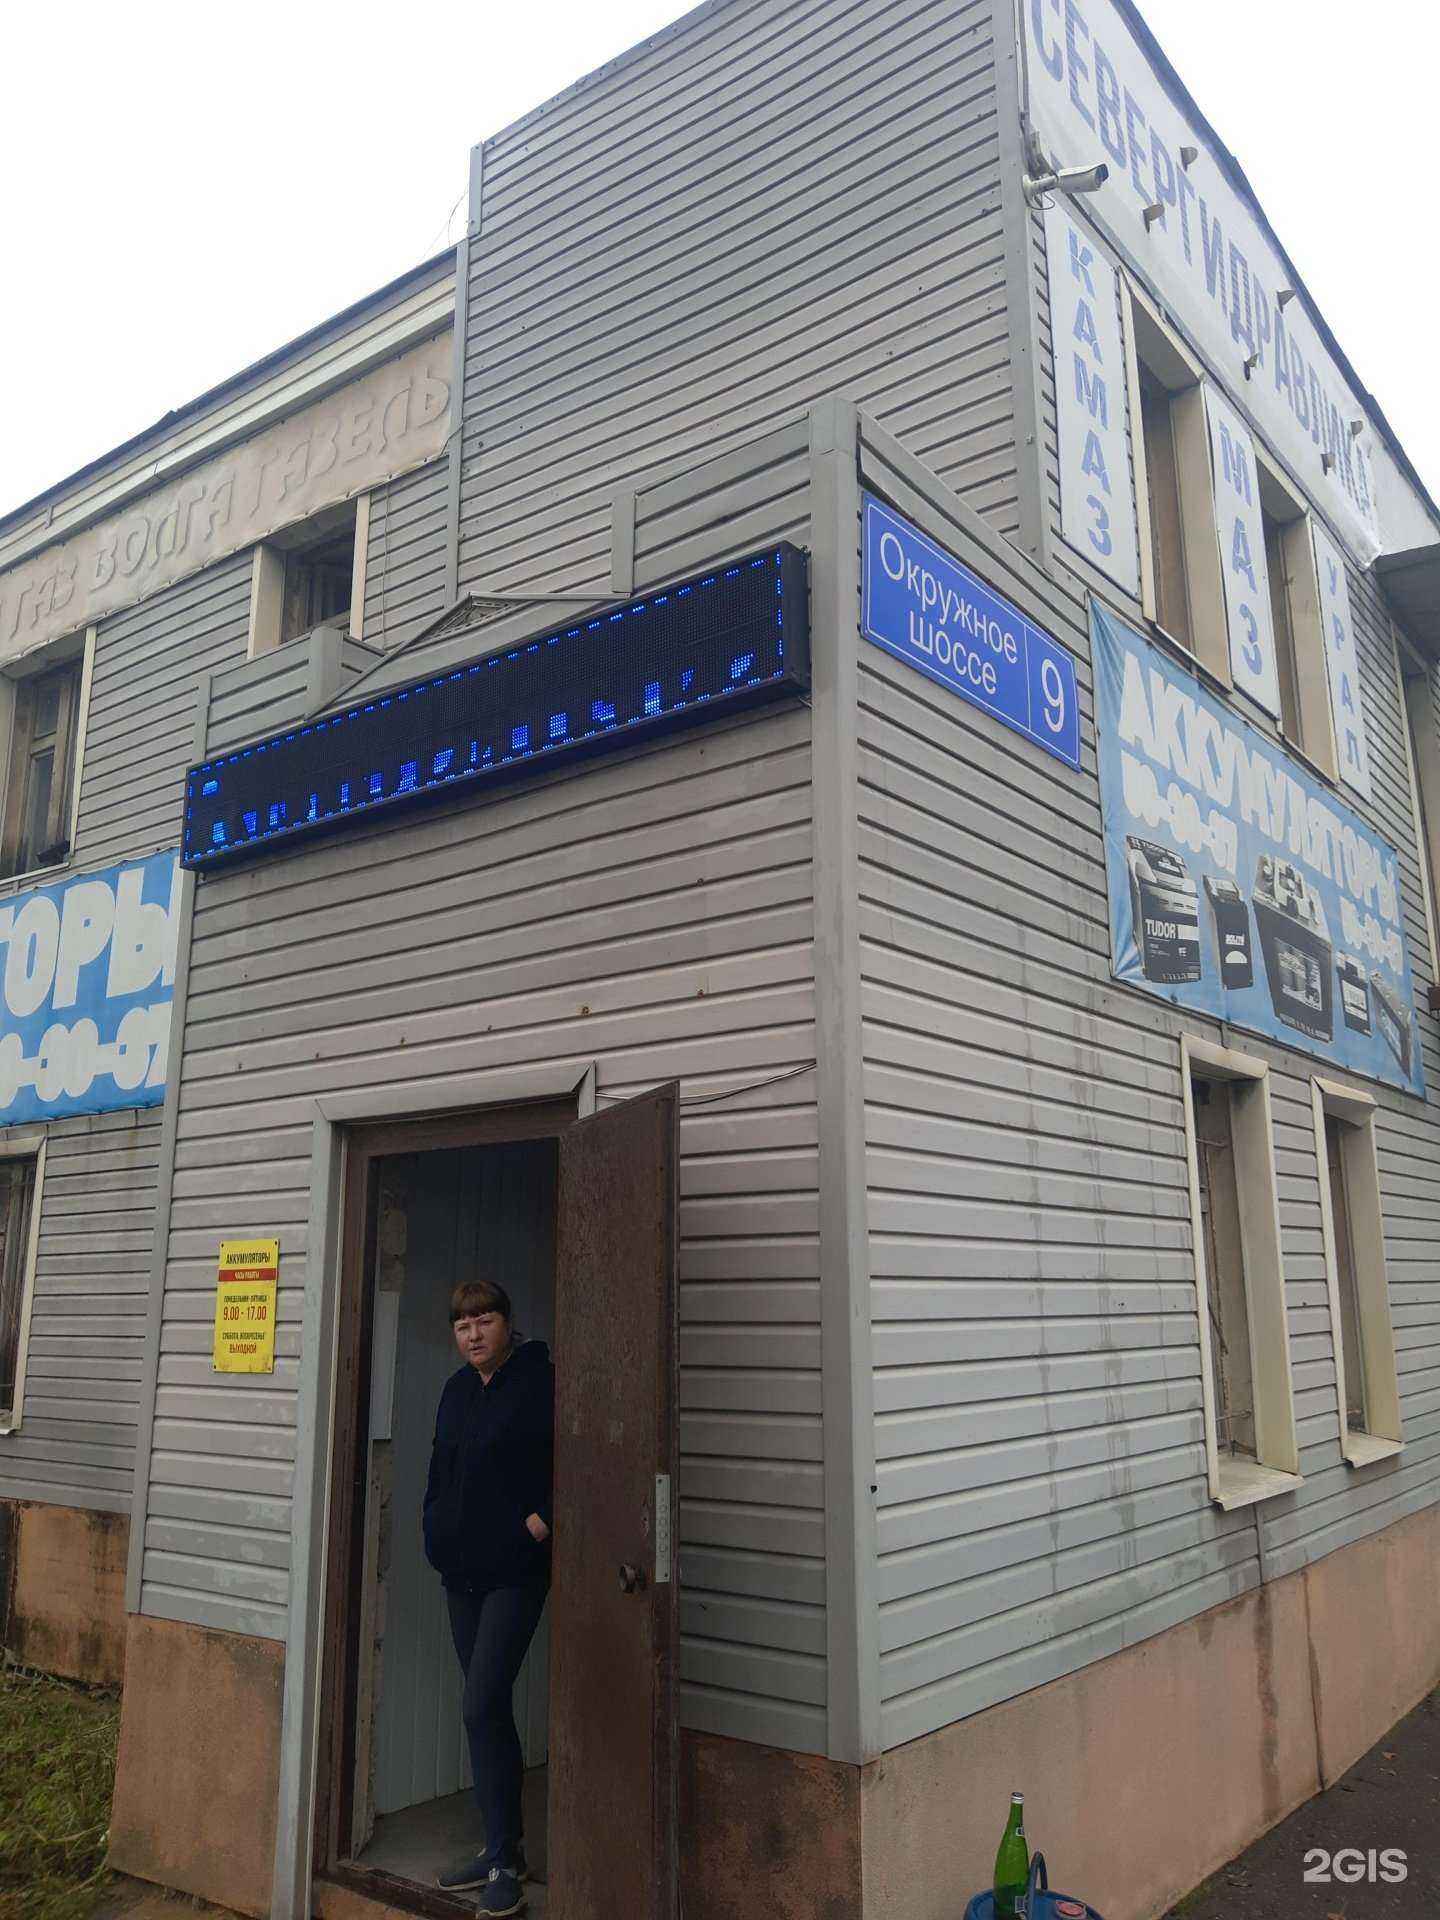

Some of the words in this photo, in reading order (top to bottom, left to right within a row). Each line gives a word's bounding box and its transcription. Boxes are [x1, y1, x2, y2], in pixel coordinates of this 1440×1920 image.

[1066, 227, 1112, 556] КАМАЗ
[880, 532, 1018, 664] Окружное
[1218, 420, 1262, 675] МАЗ
[909, 611, 997, 695] шоссе
[1041, 658, 1065, 733] 9
[1326, 557, 1361, 773] УРАЛ
[1118, 650, 1400, 926] АККУМУЛЯТОРЫ
[1145, 919, 1177, 939] TUDOR
[226, 1252, 270, 1264] АККУМУЛЯТОРЫ
[223, 1306, 240, 1320] 9.00
[247, 1305, 267, 1320] 17.00
